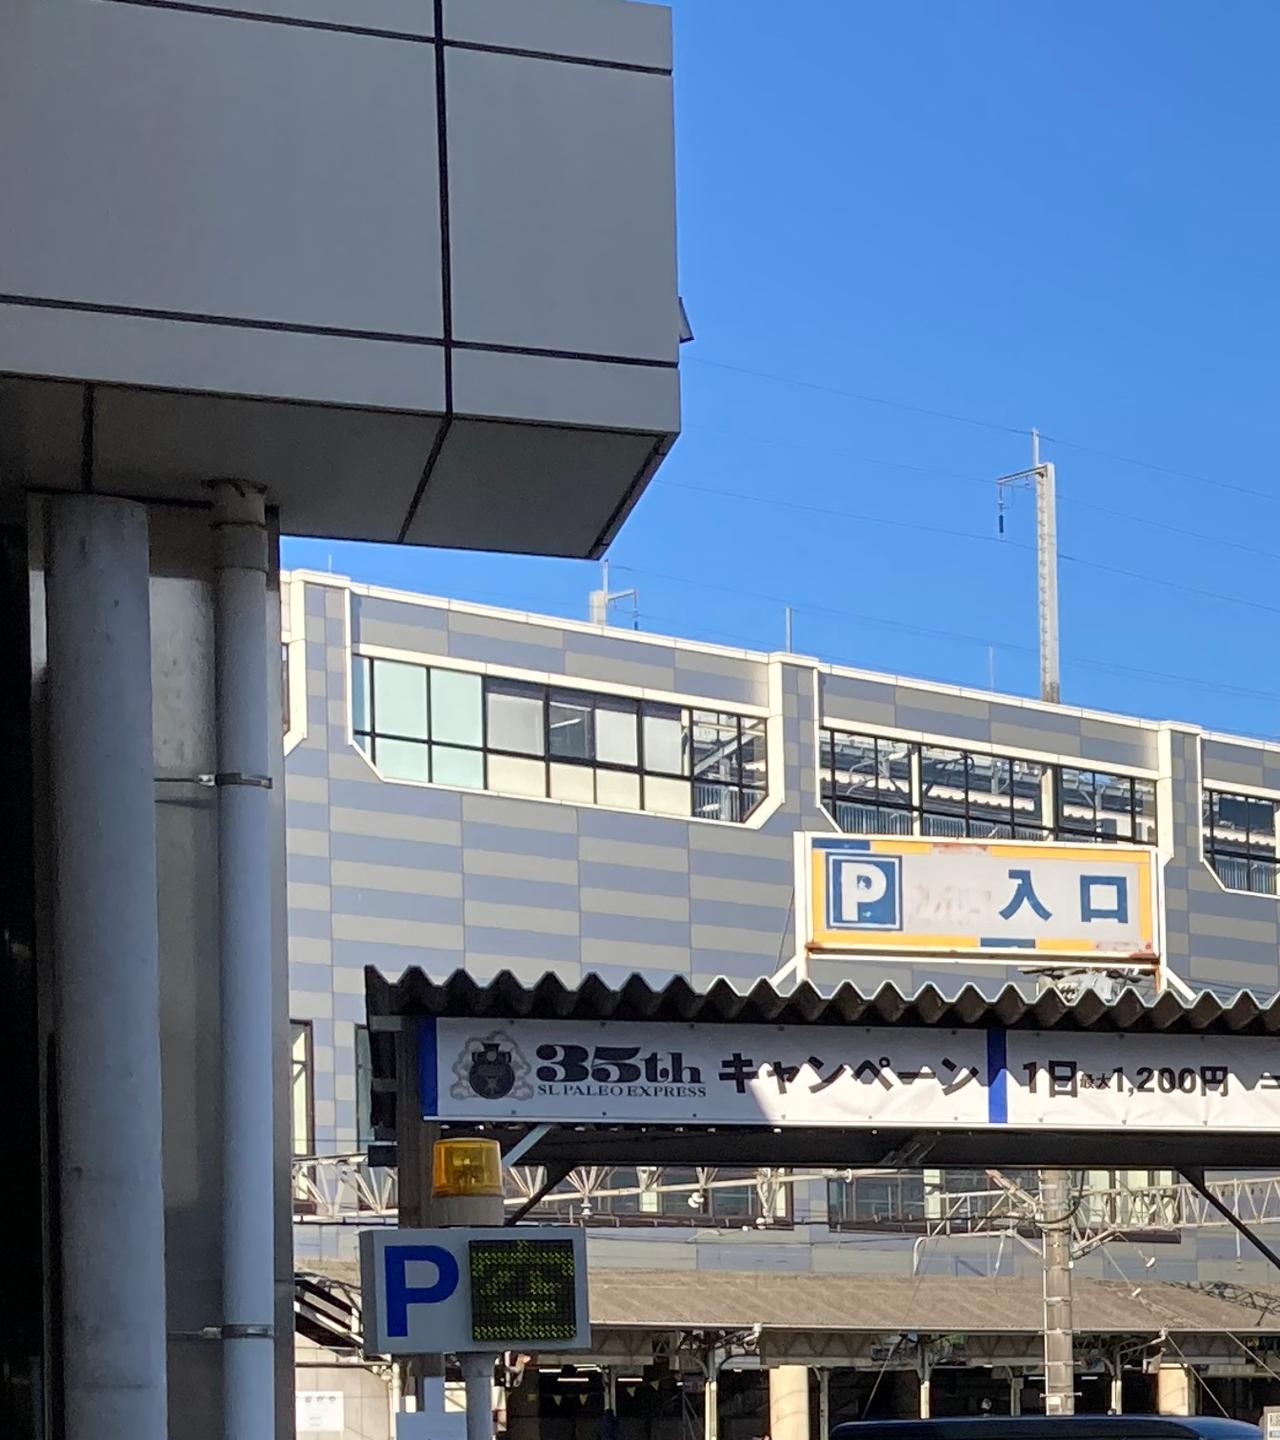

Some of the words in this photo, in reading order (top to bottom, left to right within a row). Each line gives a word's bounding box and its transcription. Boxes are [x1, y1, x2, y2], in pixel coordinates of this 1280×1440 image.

[841, 863, 887, 921] P
[999, 869, 1128, 924] 入口
[536, 1044, 705, 1084] 35th
[719, 1053, 980, 1096] キャンペーン
[538, 1083, 560, 1097] SL
[562, 1084, 625, 1098] PALEO
[626, 1085, 707, 1098] EXPRESS
[384, 1245, 459, 1338] P
